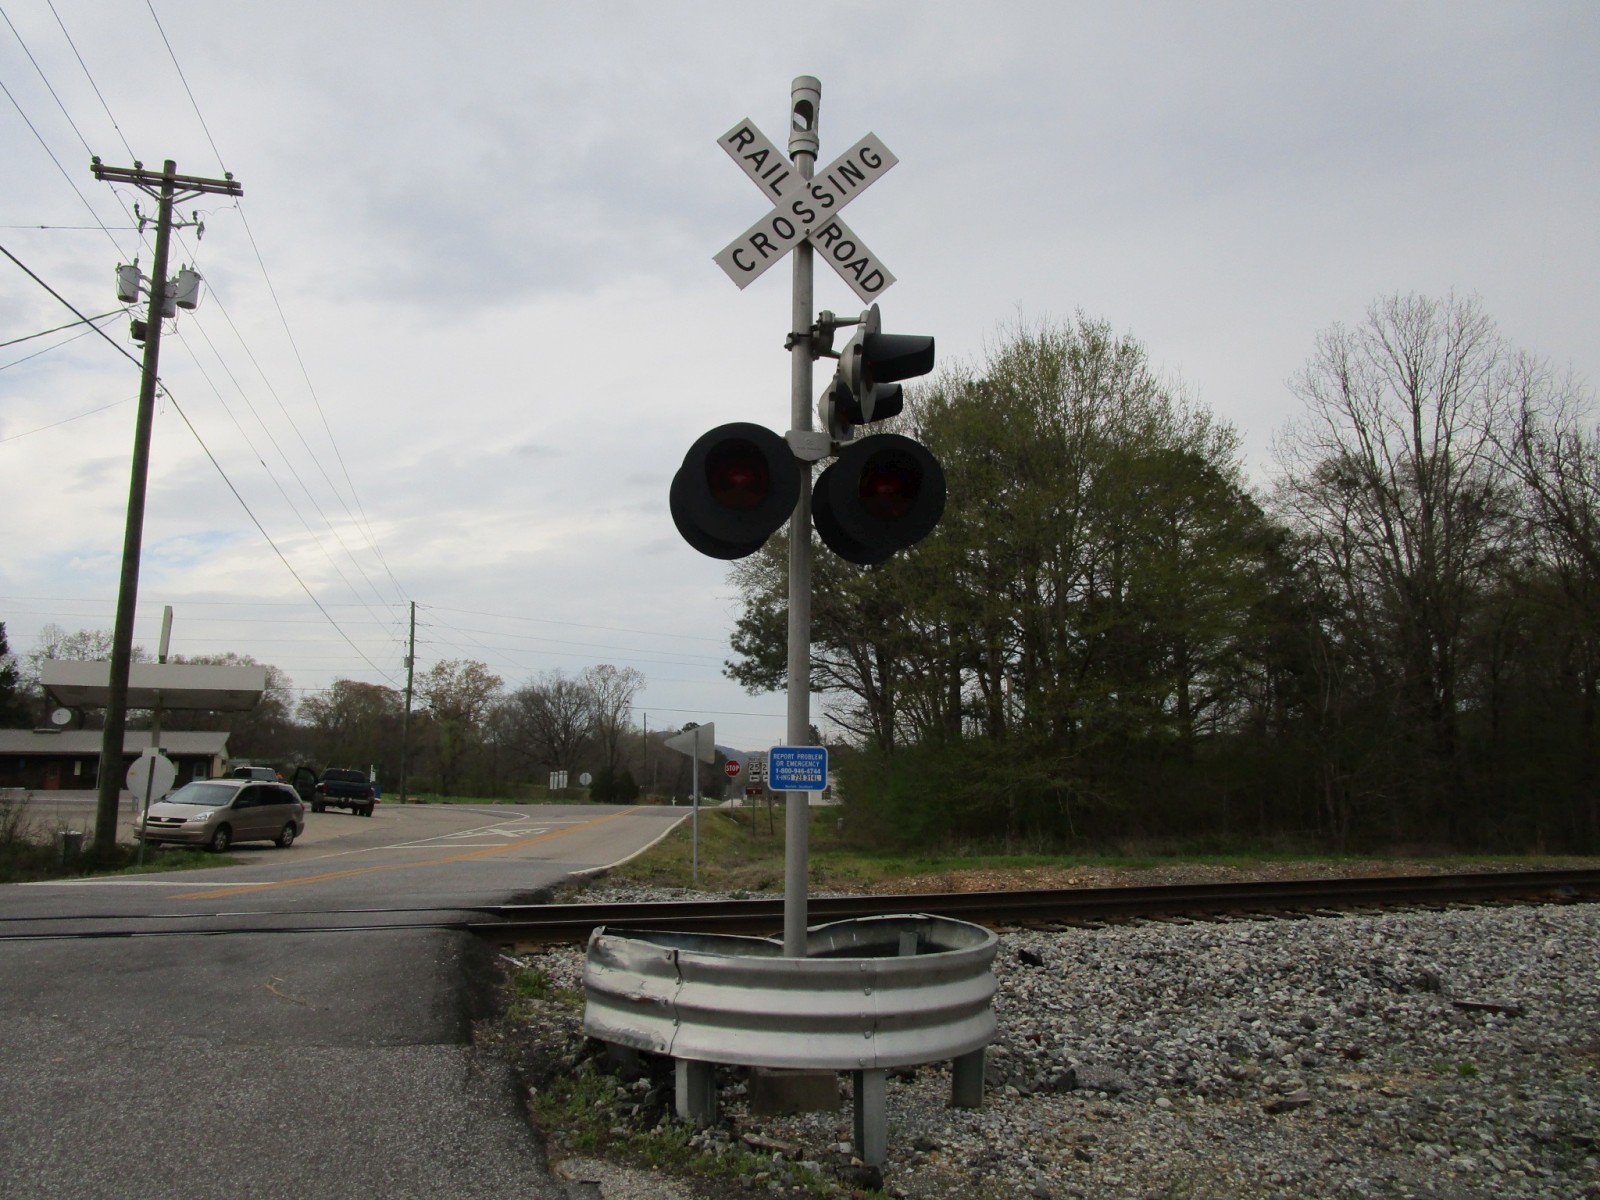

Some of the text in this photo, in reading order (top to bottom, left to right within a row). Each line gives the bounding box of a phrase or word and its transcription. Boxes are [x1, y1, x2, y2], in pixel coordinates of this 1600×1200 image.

[727, 126, 885, 293] RAIL ROAD
[732, 147, 882, 272] CROSSING
[725, 764, 740, 772] STOP
[749, 763, 760, 771] 25
